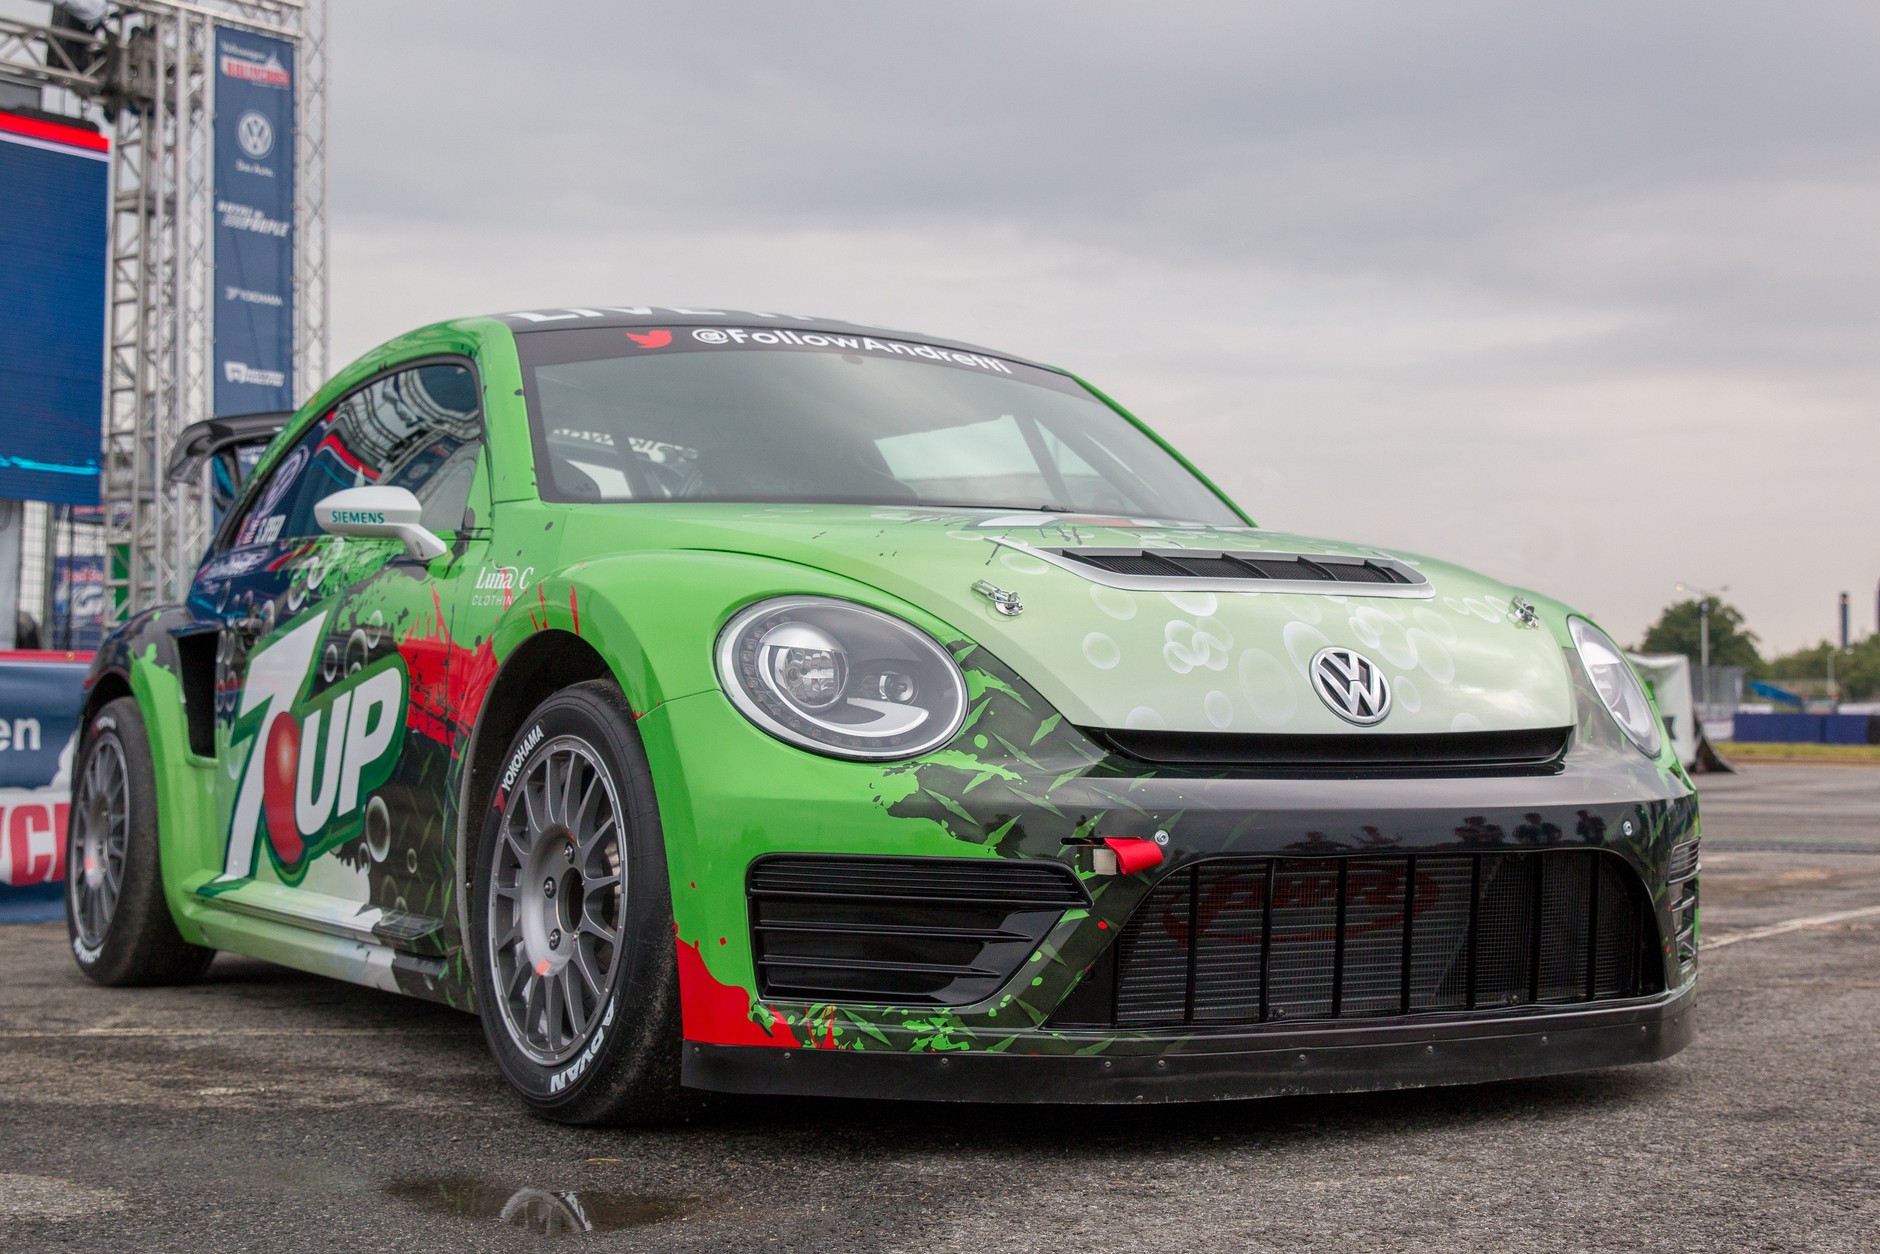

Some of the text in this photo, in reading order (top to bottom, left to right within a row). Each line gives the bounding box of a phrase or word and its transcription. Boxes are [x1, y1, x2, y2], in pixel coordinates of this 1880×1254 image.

[245, 217, 290, 237] PURPLE
[692, 328, 1012, 375] @FollowAndretti
[331, 510, 385, 524] SIEMENS
[475, 563, 535, 590] Luna C
[472, 594, 512, 606] CLOTHIN
[502, 725, 545, 792] YOKOHAMA
[550, 995, 615, 1093] ADVAN
